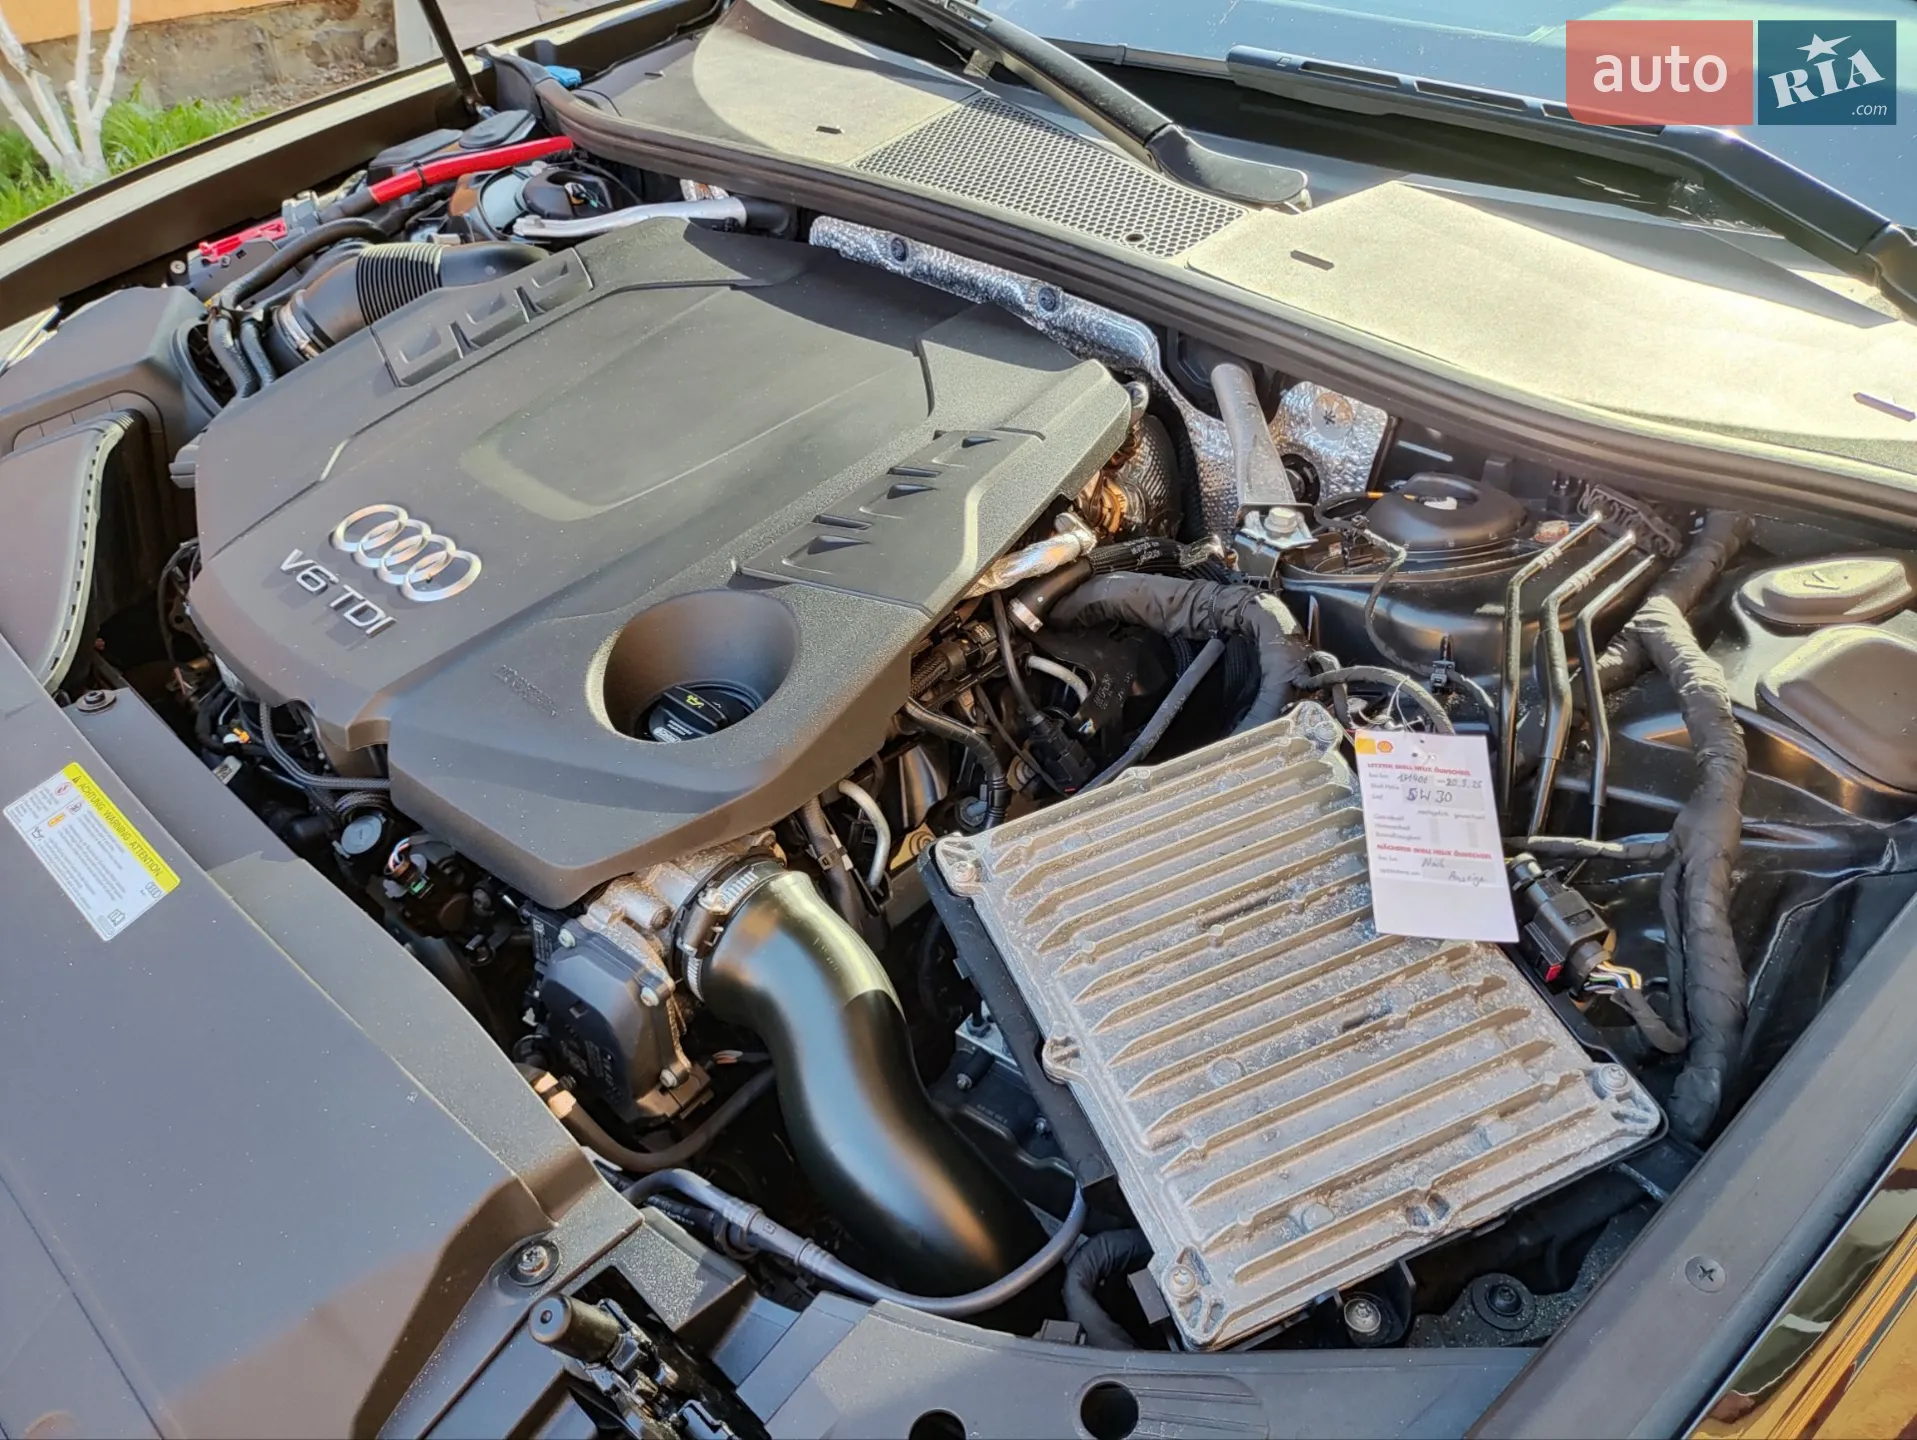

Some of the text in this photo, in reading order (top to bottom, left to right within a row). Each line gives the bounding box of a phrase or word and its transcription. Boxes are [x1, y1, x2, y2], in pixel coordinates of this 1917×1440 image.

[280, 548, 398, 636] V6 TDI
[103, 806, 132, 842] WARNING
[129, 839, 164, 878] ATTENTION
